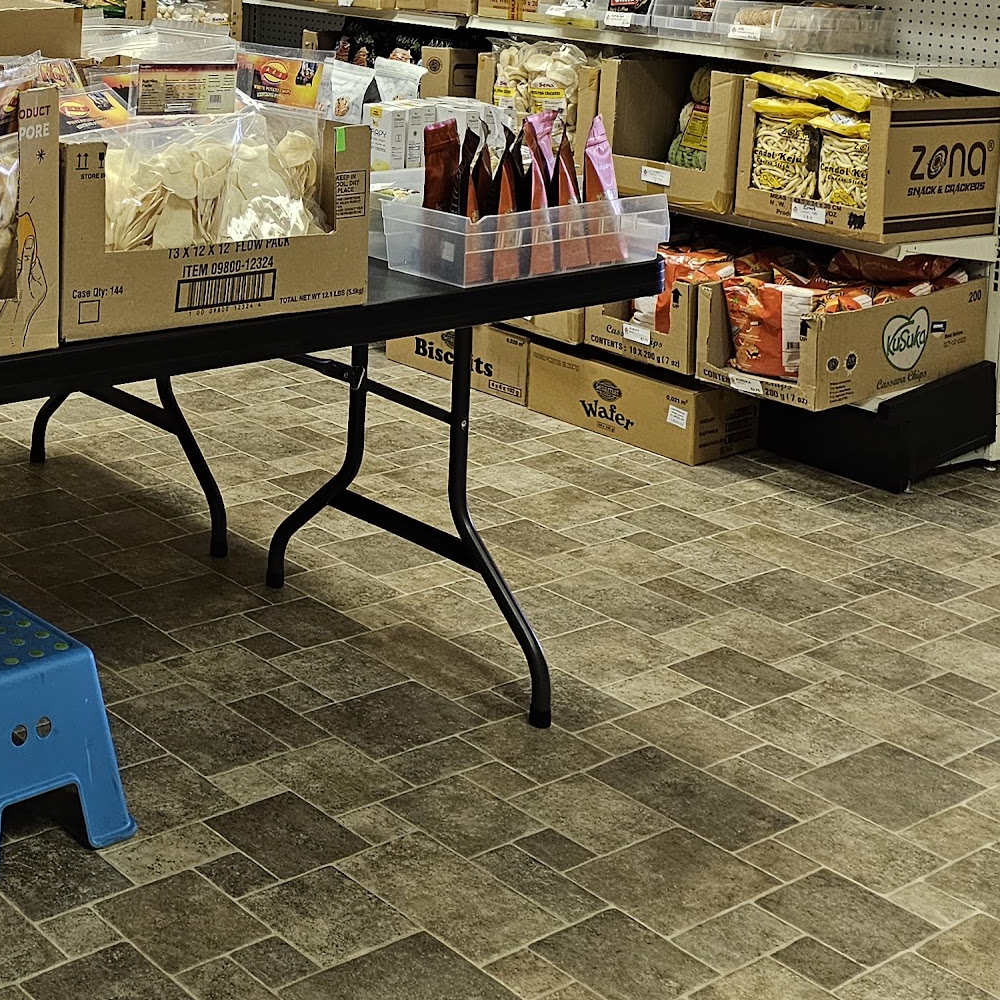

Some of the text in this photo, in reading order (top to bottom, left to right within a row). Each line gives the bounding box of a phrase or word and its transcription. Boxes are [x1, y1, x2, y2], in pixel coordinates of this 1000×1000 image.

[778, 150, 802, 165] Keju
[820, 163, 850, 177] Cendol
[769, 193, 787, 201] MEAS
[907, 181, 986, 198] SNACK & CRACKERS
[183, 236, 290, 258] X X 12 FLOW PACK
[182, 256, 274, 278] ITEM 09800-12324
[72, 286, 124, 300] Case Qty: 144
[279, 296, 298, 304] TOTAL
[334, 290, 345, 298] LBS
[968, 290, 982, 303] 200
[415, 337, 494, 378] Biscits
[629, 346, 655, 361] 10 200
[876, 376, 903, 391] Cassava
[904, 370, 927, 384] Chips
[580, 400, 634, 431] Wafer
